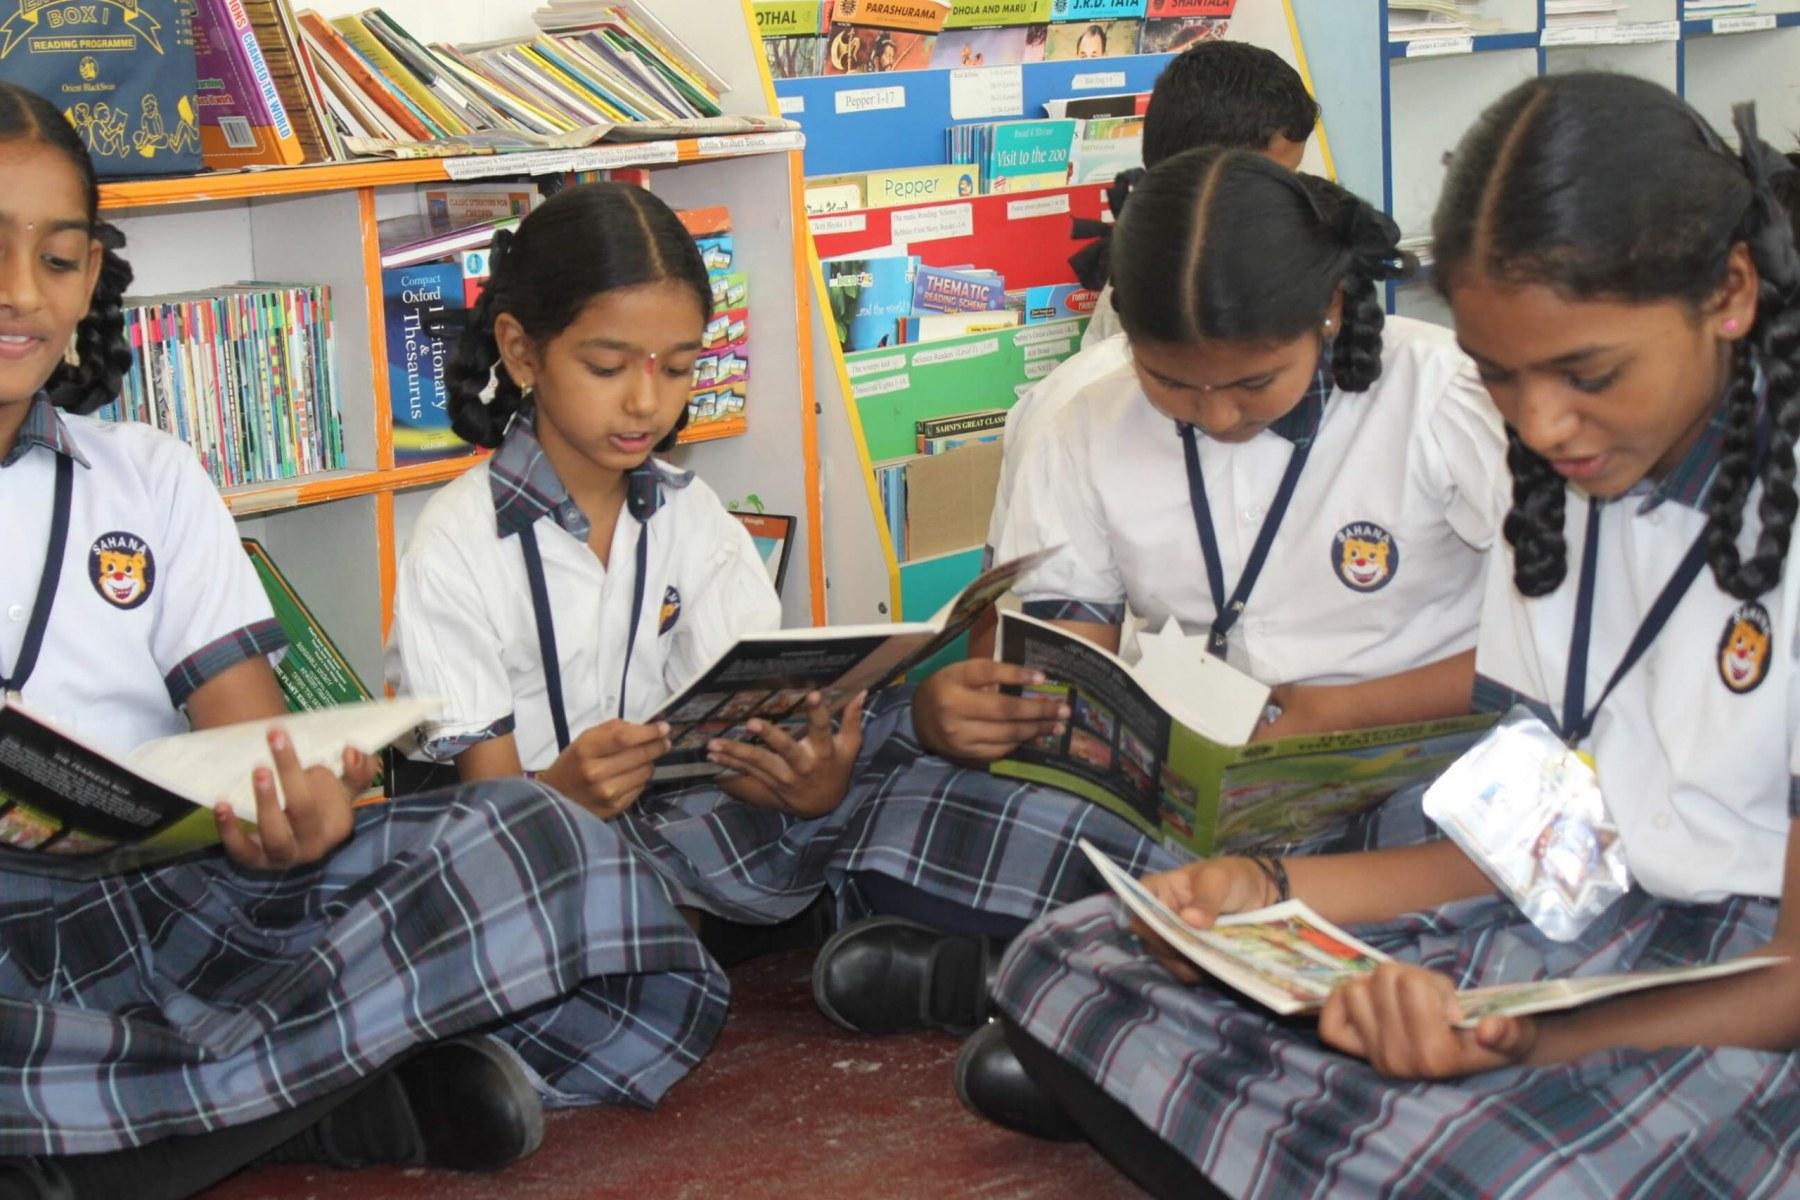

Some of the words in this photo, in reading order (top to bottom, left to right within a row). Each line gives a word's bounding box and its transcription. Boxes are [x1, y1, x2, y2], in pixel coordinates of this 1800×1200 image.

[47, 5, 97, 28] BOX
[866, 2, 936, 20] PARASHURAMA
[952, 5, 980, 15] DHOLA
[982, 4, 1000, 13] AND
[1002, 3, 1027, 13] MARU
[33, 40, 79, 50] READING
[79, 39, 134, 49] PROGRAMME
[243, 33, 268, 83] CHANGED
[262, 81, 276, 102] THE
[269, 100, 292, 138] WORLD
[845, 94, 874, 110] Pepper
[997, 150, 1016, 168] Visit
[1019, 150, 1030, 165] to
[1031, 145, 1047, 163] the
[1048, 149, 1066, 162] zoo
[885, 177, 939, 198] Pepper
[401, 273, 441, 287] Compact
[927, 275, 990, 302] THEMATIC
[402, 286, 441, 304] Oxford
[924, 291, 957, 305] READING
[959, 298, 987, 312] SCHEME
[420, 344, 429, 356] &
[403, 307, 423, 420] Thesaurus
[962, 418, 984, 429] GREAT
[1337, 525, 1390, 543] SAHANA
[93, 536, 147, 555] SAHANA
